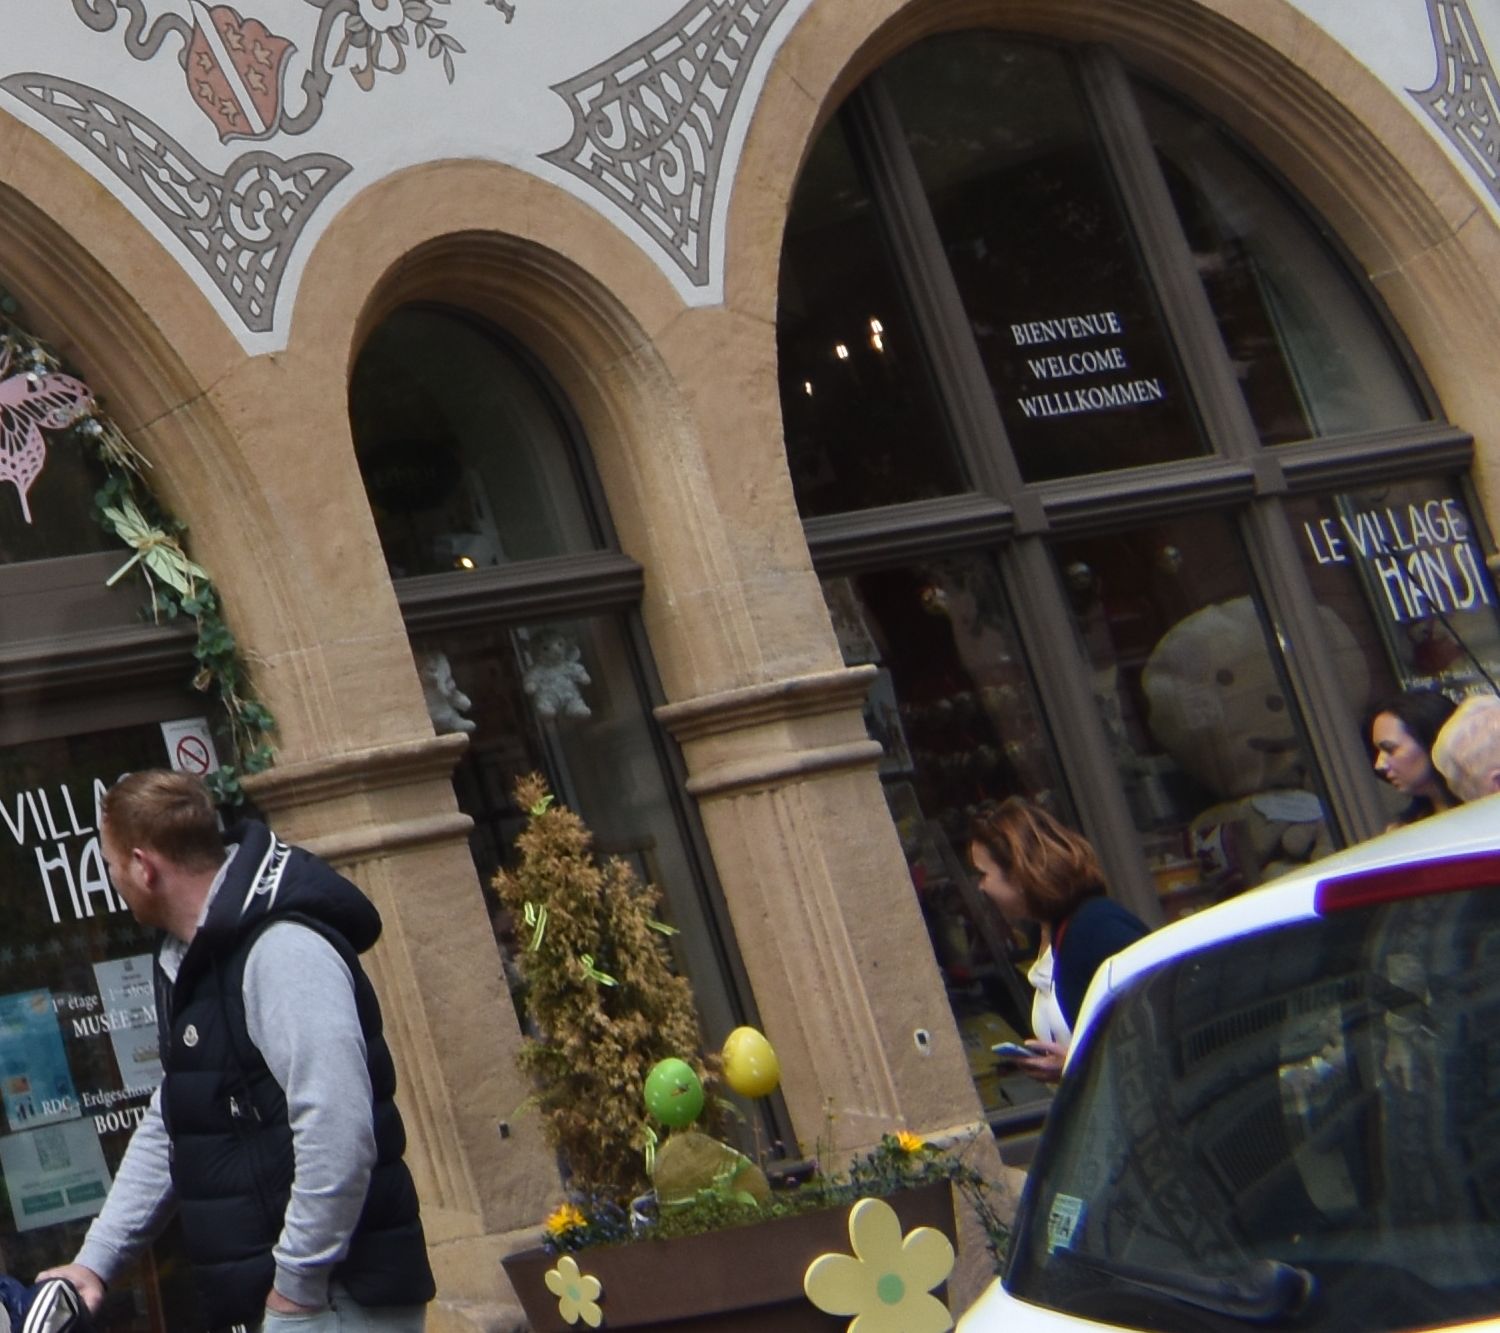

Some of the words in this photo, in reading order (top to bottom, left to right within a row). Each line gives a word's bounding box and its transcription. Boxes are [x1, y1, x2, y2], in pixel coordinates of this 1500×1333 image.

[1010, 311, 1122, 346] BIENVENUE
[1027, 347, 1126, 380] WELCOME
[1017, 378, 1164, 418] WILLLKOMMEN
[1303, 517, 1346, 564] LE
[1340, 498, 1468, 557] VILLAGE
[1374, 541, 1489, 621] HANSI
[72, 1007, 132, 1038] MUSÉE
[41, 1095, 73, 1116] RDC
[94, 1104, 147, 1134] BOUT
